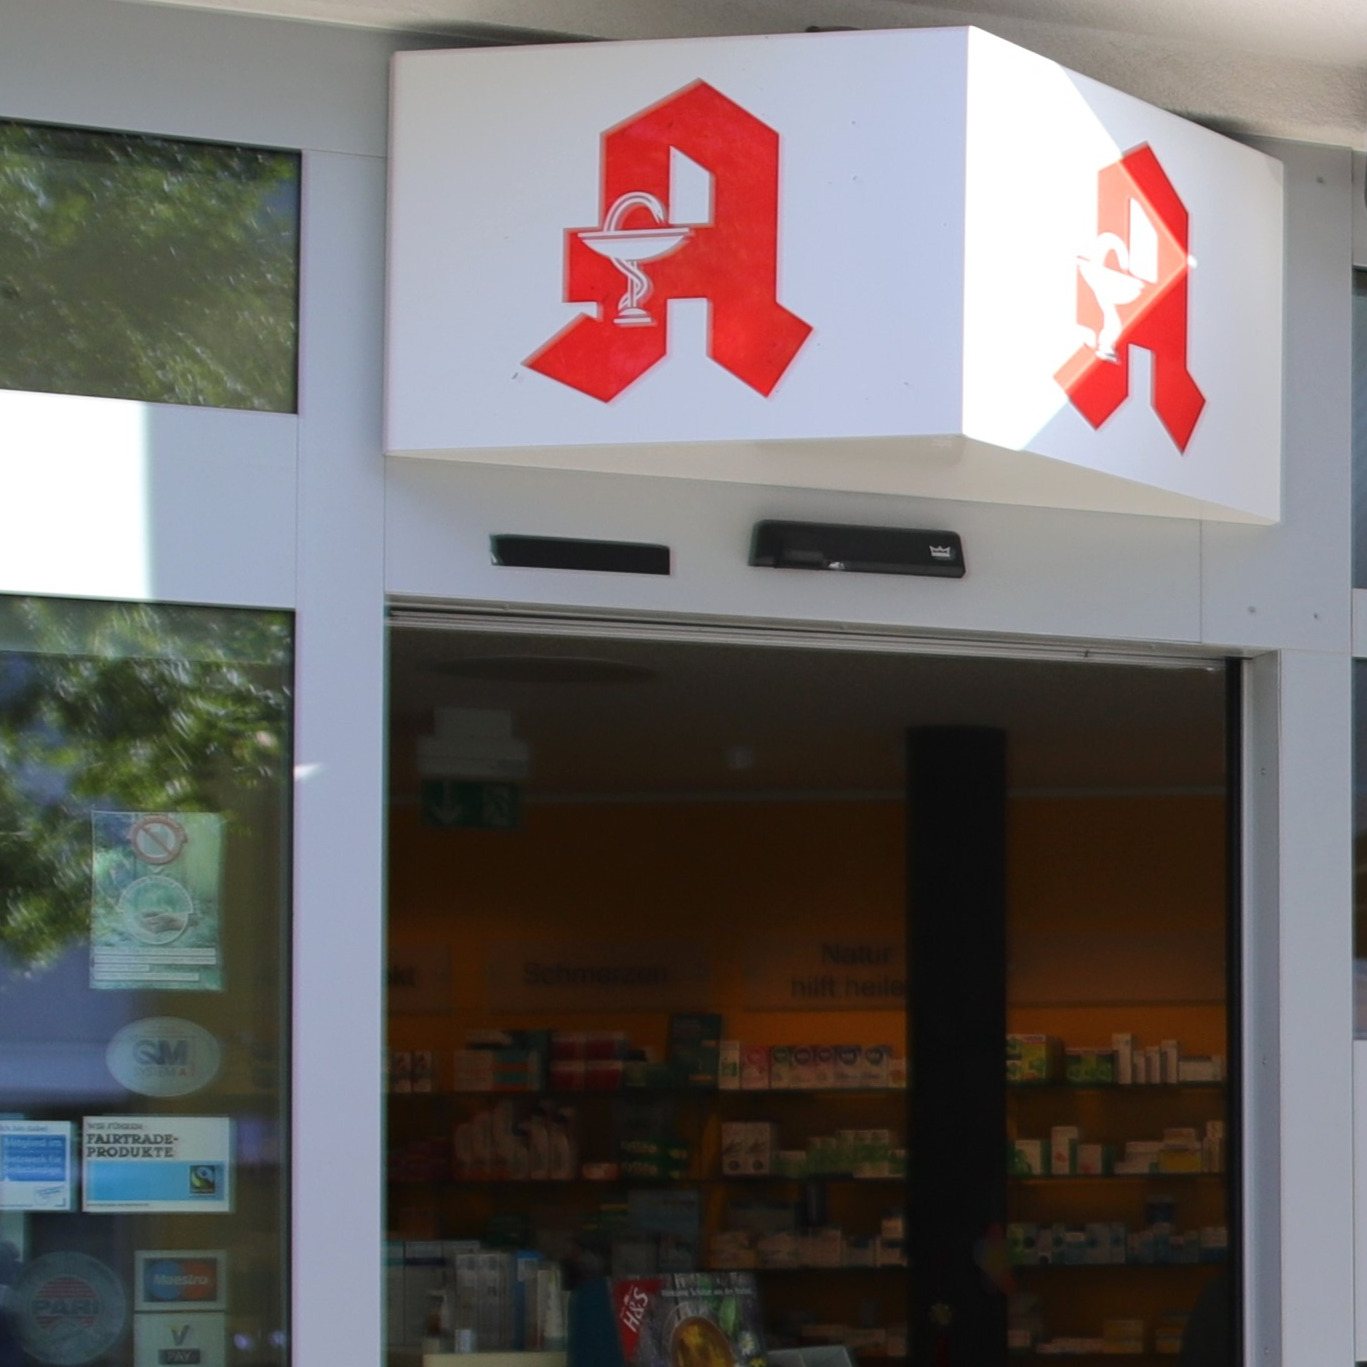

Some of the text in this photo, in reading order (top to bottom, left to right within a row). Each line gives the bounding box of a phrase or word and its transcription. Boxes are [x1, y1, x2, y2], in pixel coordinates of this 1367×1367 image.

[822, 942, 892, 965] Natur
[791, 974, 909, 999] hilft heile
[86, 1133, 179, 1145] FAIRTRADE-
[86, 1146, 174, 1158] PRODUKTE
[31, 1299, 100, 1315] PARI
[623, 1286, 649, 1334] H&S
